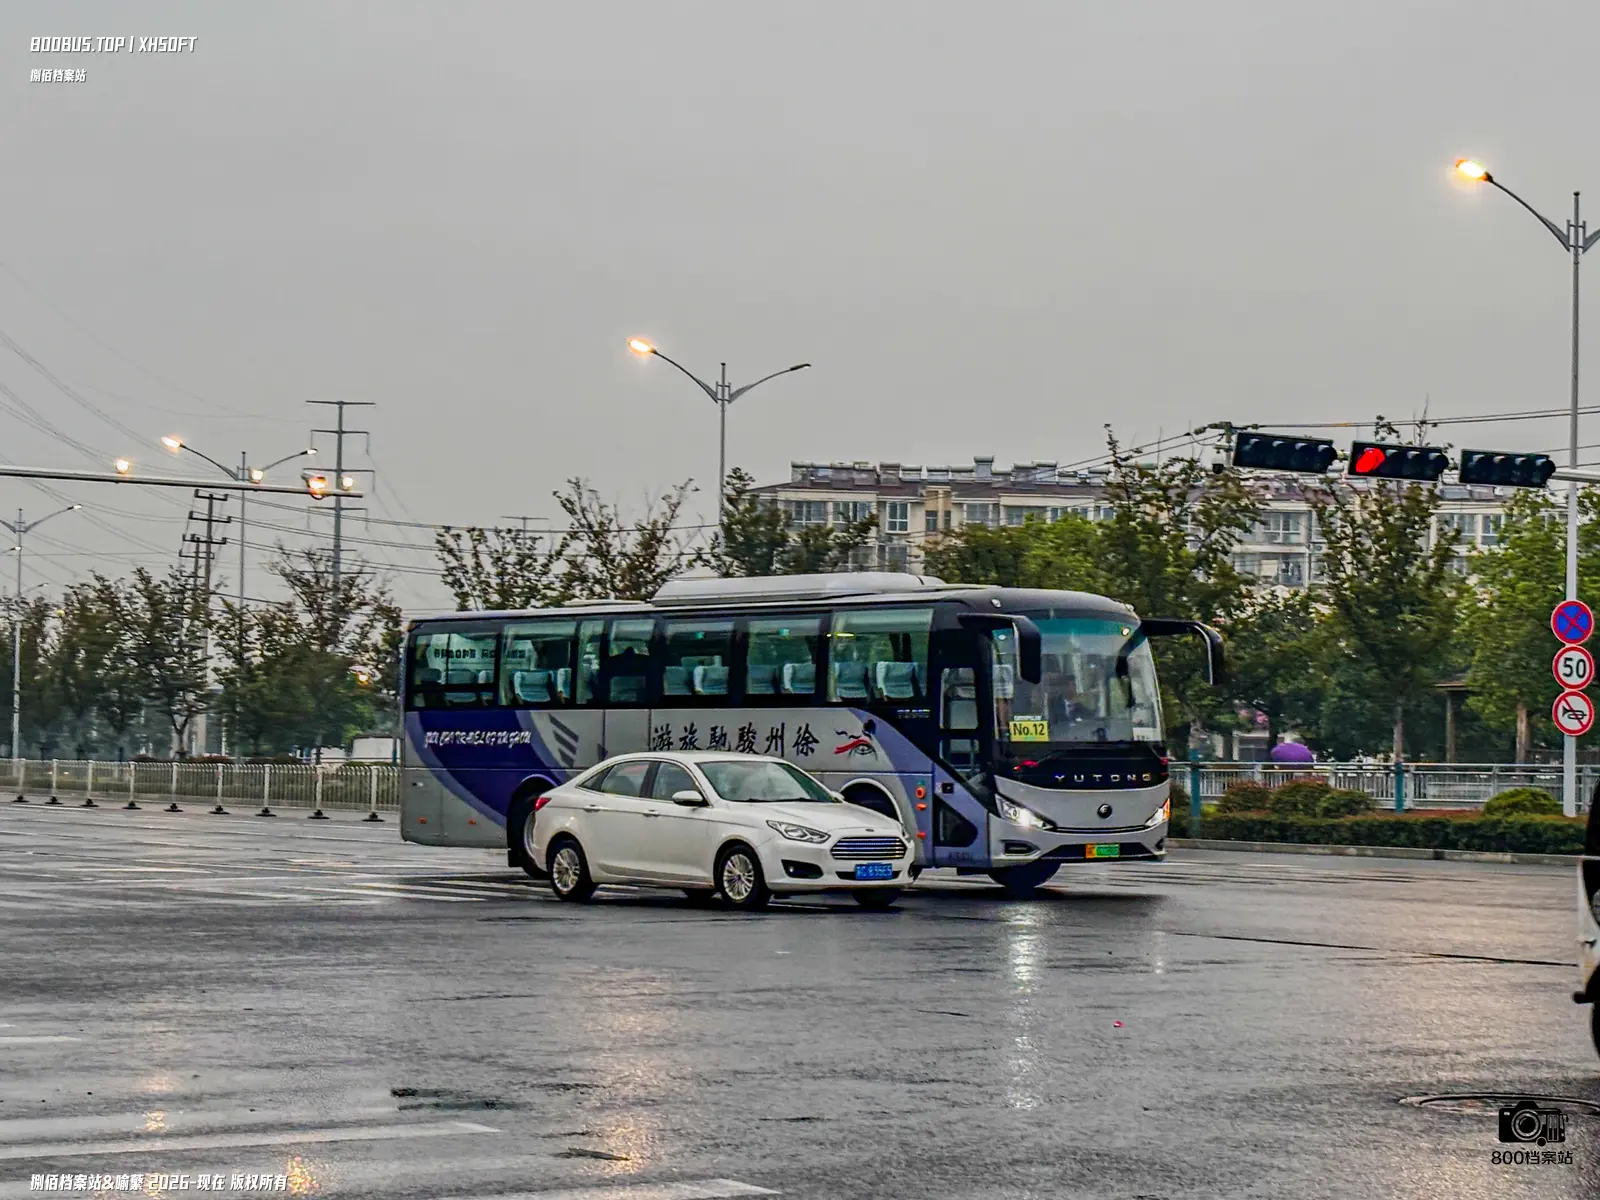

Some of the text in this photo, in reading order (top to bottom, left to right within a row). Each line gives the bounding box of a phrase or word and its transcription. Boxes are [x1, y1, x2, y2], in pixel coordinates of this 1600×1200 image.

[1564, 657, 1585, 678] 50
[1012, 722, 1046, 737] No.12
[1054, 772, 1152, 784] YUTONG
